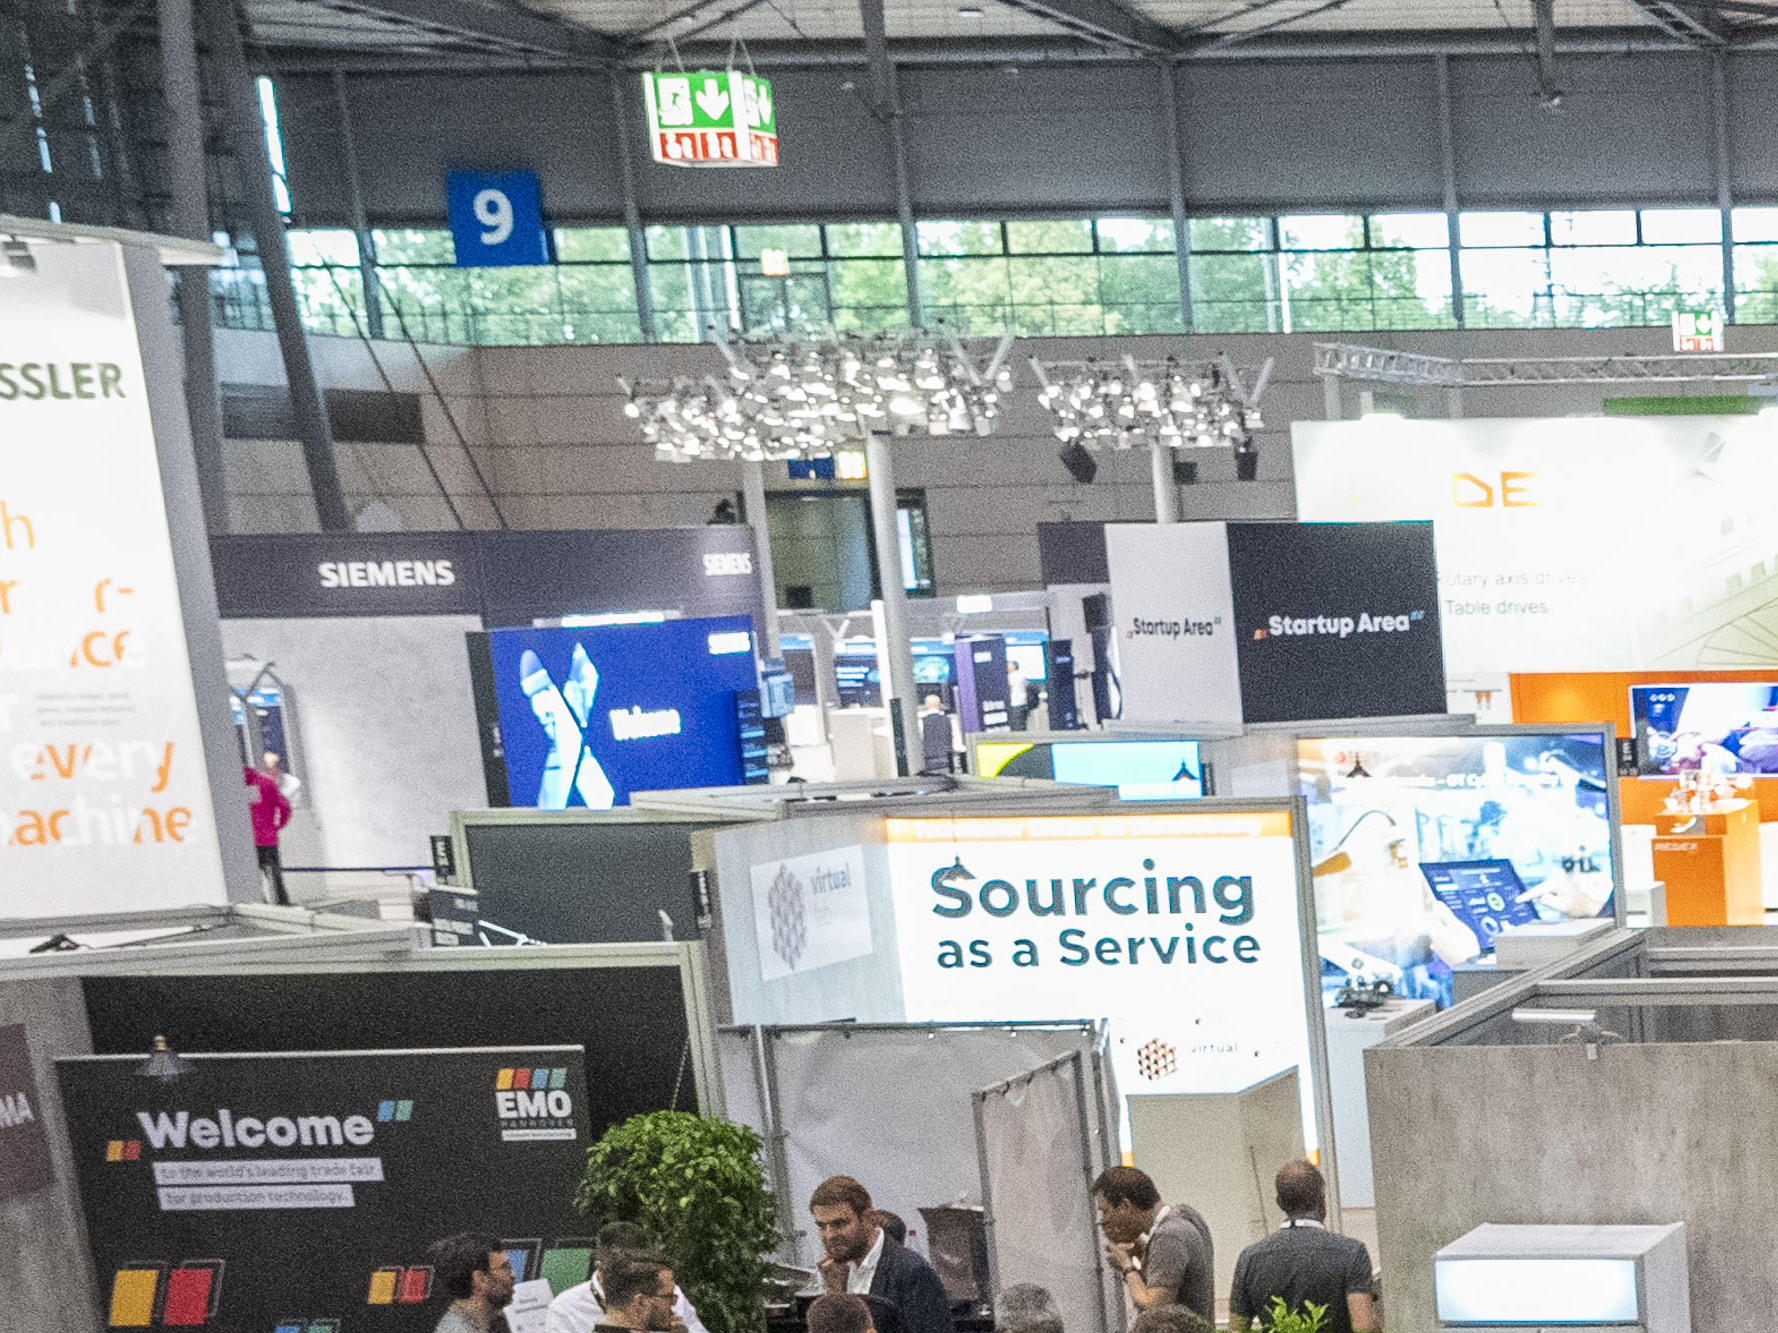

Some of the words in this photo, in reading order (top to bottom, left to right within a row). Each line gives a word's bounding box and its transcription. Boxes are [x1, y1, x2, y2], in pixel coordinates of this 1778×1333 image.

[473, 188, 515, 246] 9
[319, 560, 456, 588] SIEMENS
[1496, 572, 1529, 585] axis
[1446, 599, 1491, 615] Table
[1497, 599, 1548, 615] drives
[1133, 617, 1181, 640] Startup
[1184, 618, 1213, 637] Area
[1269, 612, 1355, 639] Startup
[1357, 611, 1411, 633] Area
[810, 862, 853, 894] virtual
[930, 858, 1256, 925] Sourcing
[936, 937, 993, 969] as
[1012, 938, 1040, 968] a
[1058, 924, 1260, 967] Service
[498, 1090, 573, 1119] EMO
[137, 1108, 375, 1150] Welcome
[162, 1167, 179, 1180] to
[181, 1166, 204, 1180] the
[255, 1165, 309, 1182] leading
[311, 1165, 346, 1178] trade
